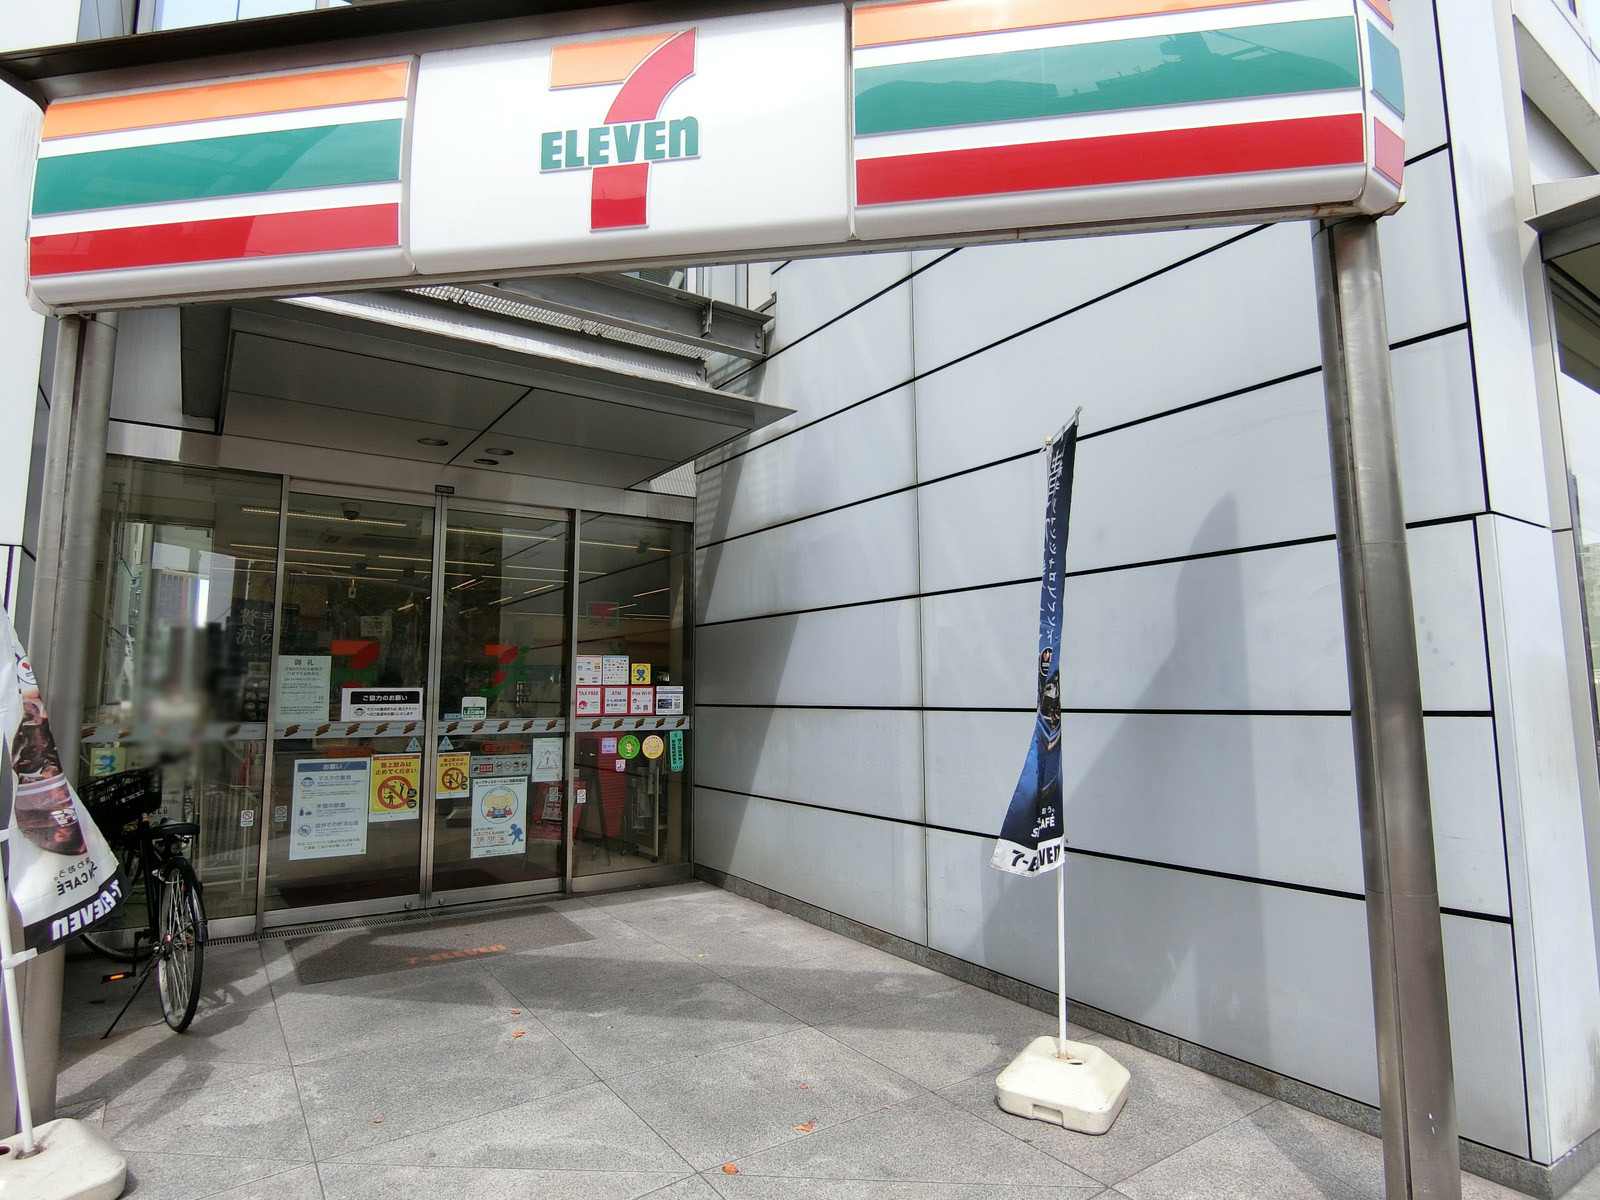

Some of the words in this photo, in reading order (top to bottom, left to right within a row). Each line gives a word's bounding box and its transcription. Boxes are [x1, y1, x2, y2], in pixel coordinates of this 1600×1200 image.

[550, 27, 696, 231] 7
[362, 694, 408, 702] ご協力のお願い
